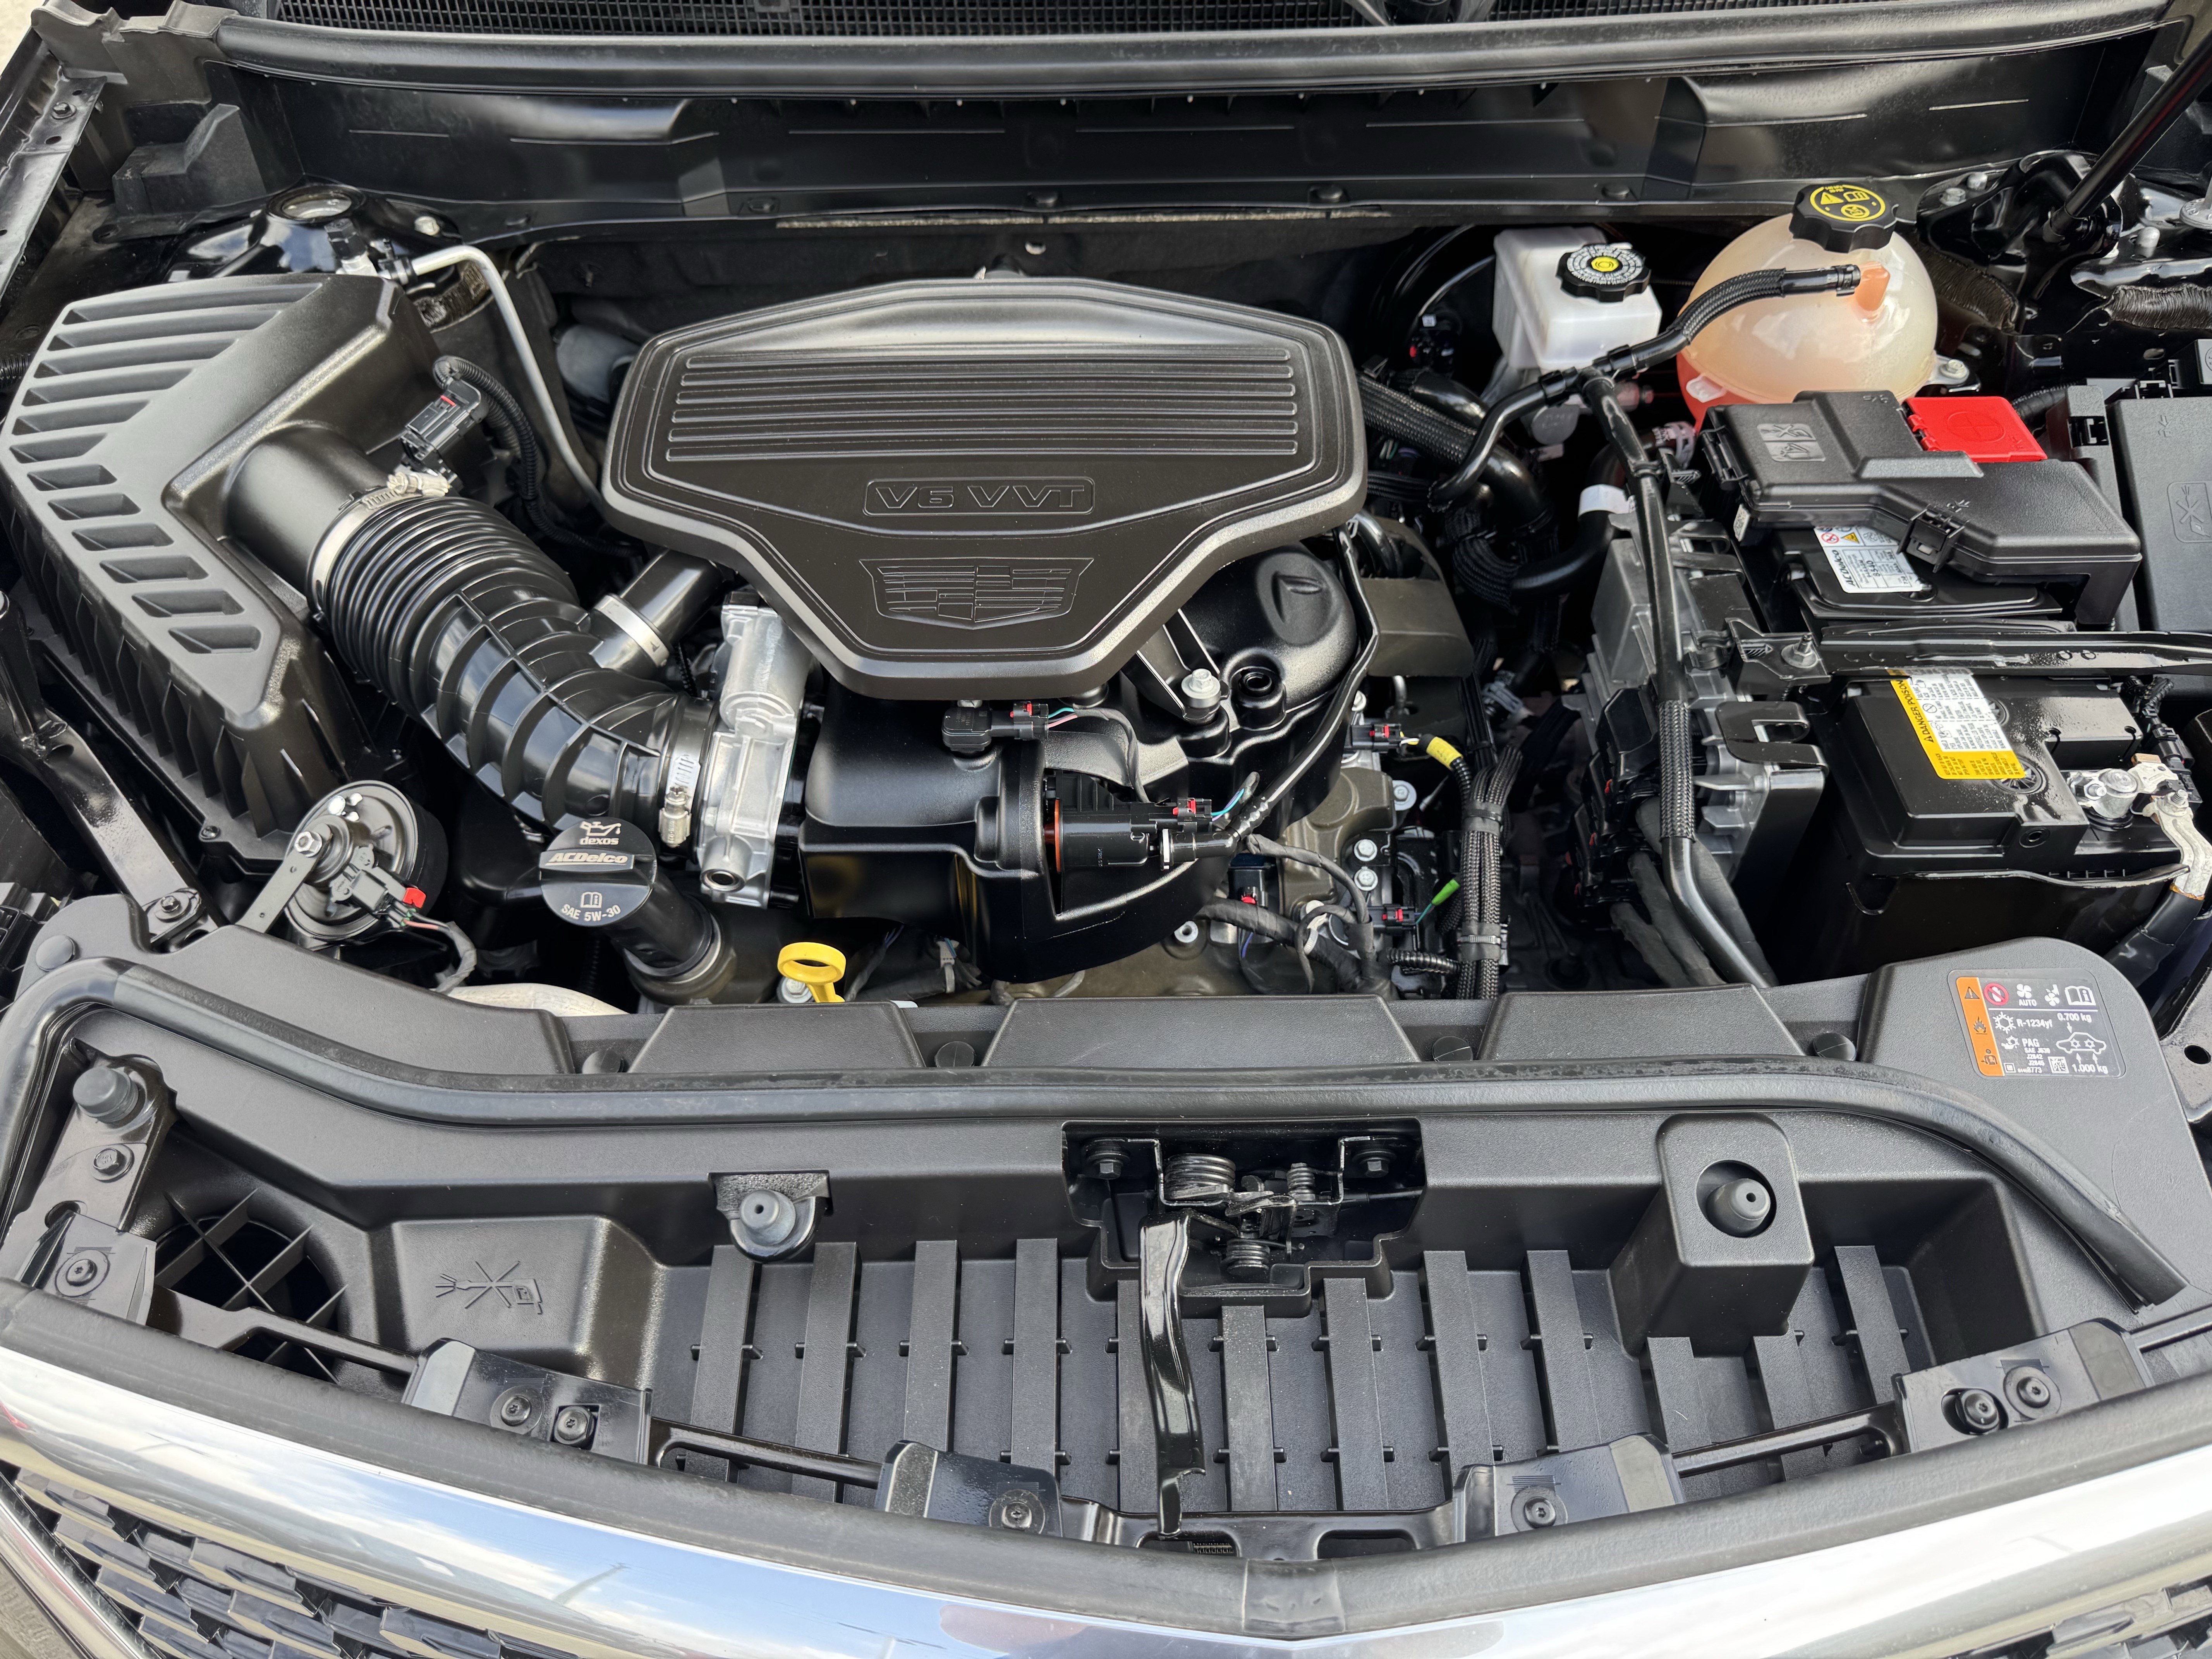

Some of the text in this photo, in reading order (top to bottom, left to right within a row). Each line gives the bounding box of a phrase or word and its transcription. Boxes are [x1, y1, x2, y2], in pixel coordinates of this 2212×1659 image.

[876, 485, 1085, 508] V6 VVT
[1832, 550, 1855, 586] ACDelco
[1897, 680, 1930, 735] DANGER POISON
[580, 836, 619, 845] dexos
[548, 852, 628, 863] ACDelco
[562, 904, 621, 922] SAE 5W-30
[2057, 1012, 2092, 1023] 0.700 kg
[2016, 1018, 2053, 1029] R-1234yf
[2021, 1038, 2040, 1048] PAG
[2072, 1063, 2109, 1074] 1.000 kg
